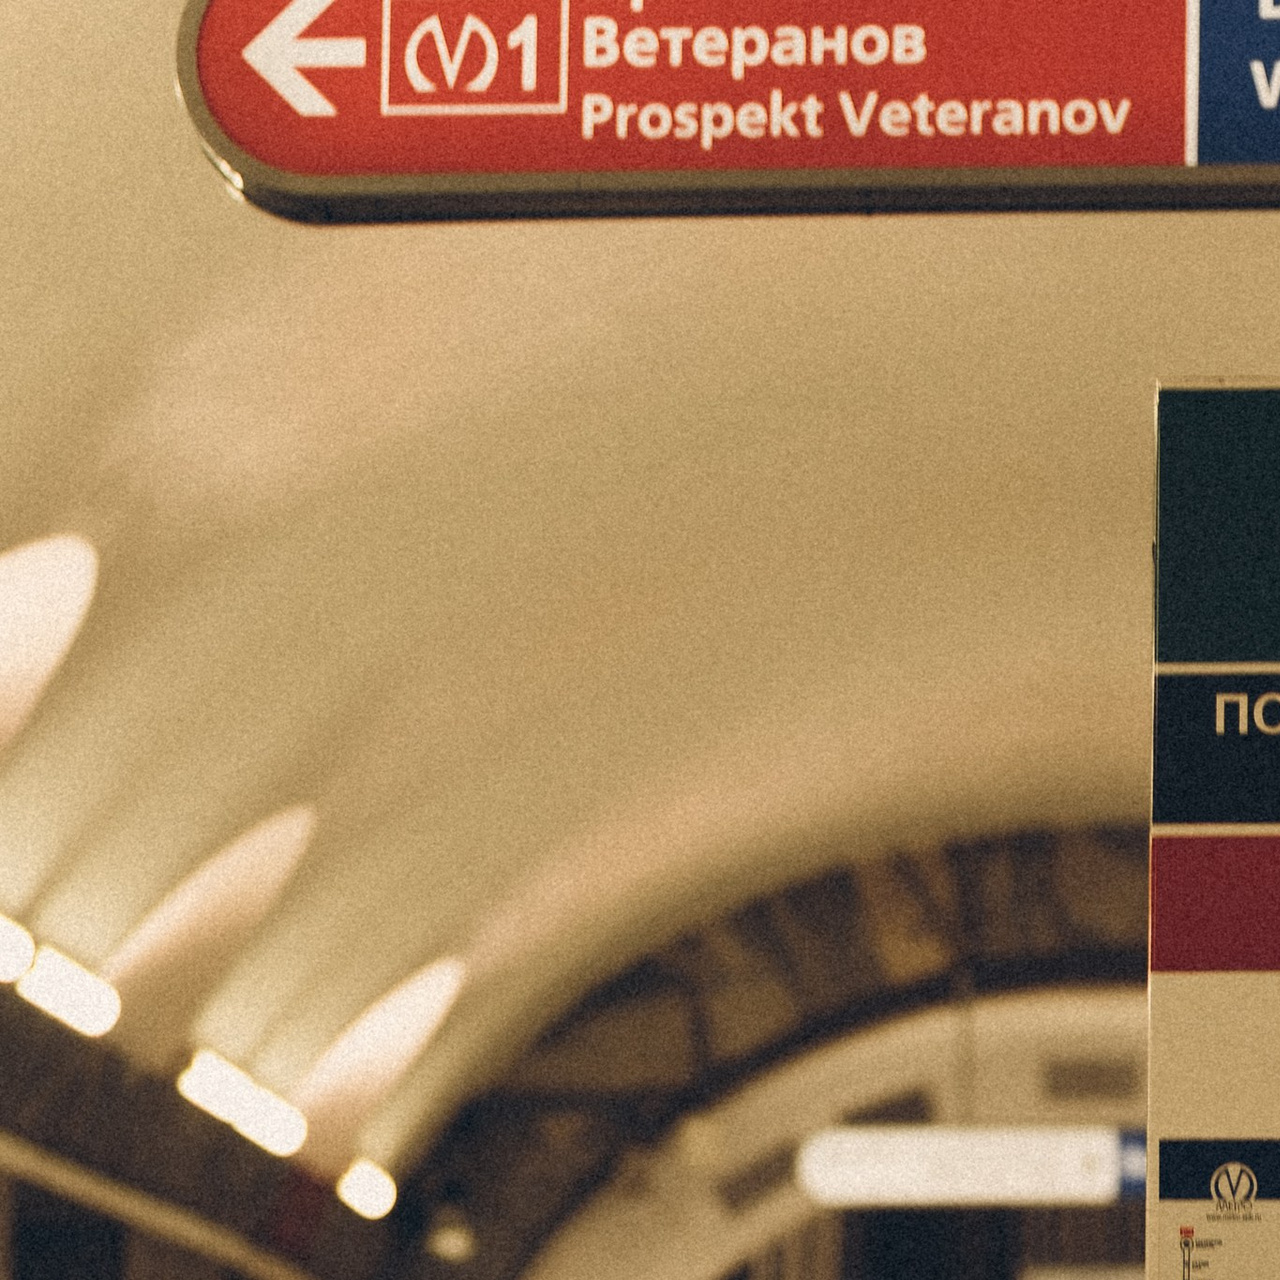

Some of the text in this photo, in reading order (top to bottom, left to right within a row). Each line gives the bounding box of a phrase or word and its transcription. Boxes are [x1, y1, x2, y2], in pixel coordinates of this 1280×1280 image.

[582, 15, 927, 80] Ветеранов
[581, 88, 1132, 150] Prospekt Veteranov
